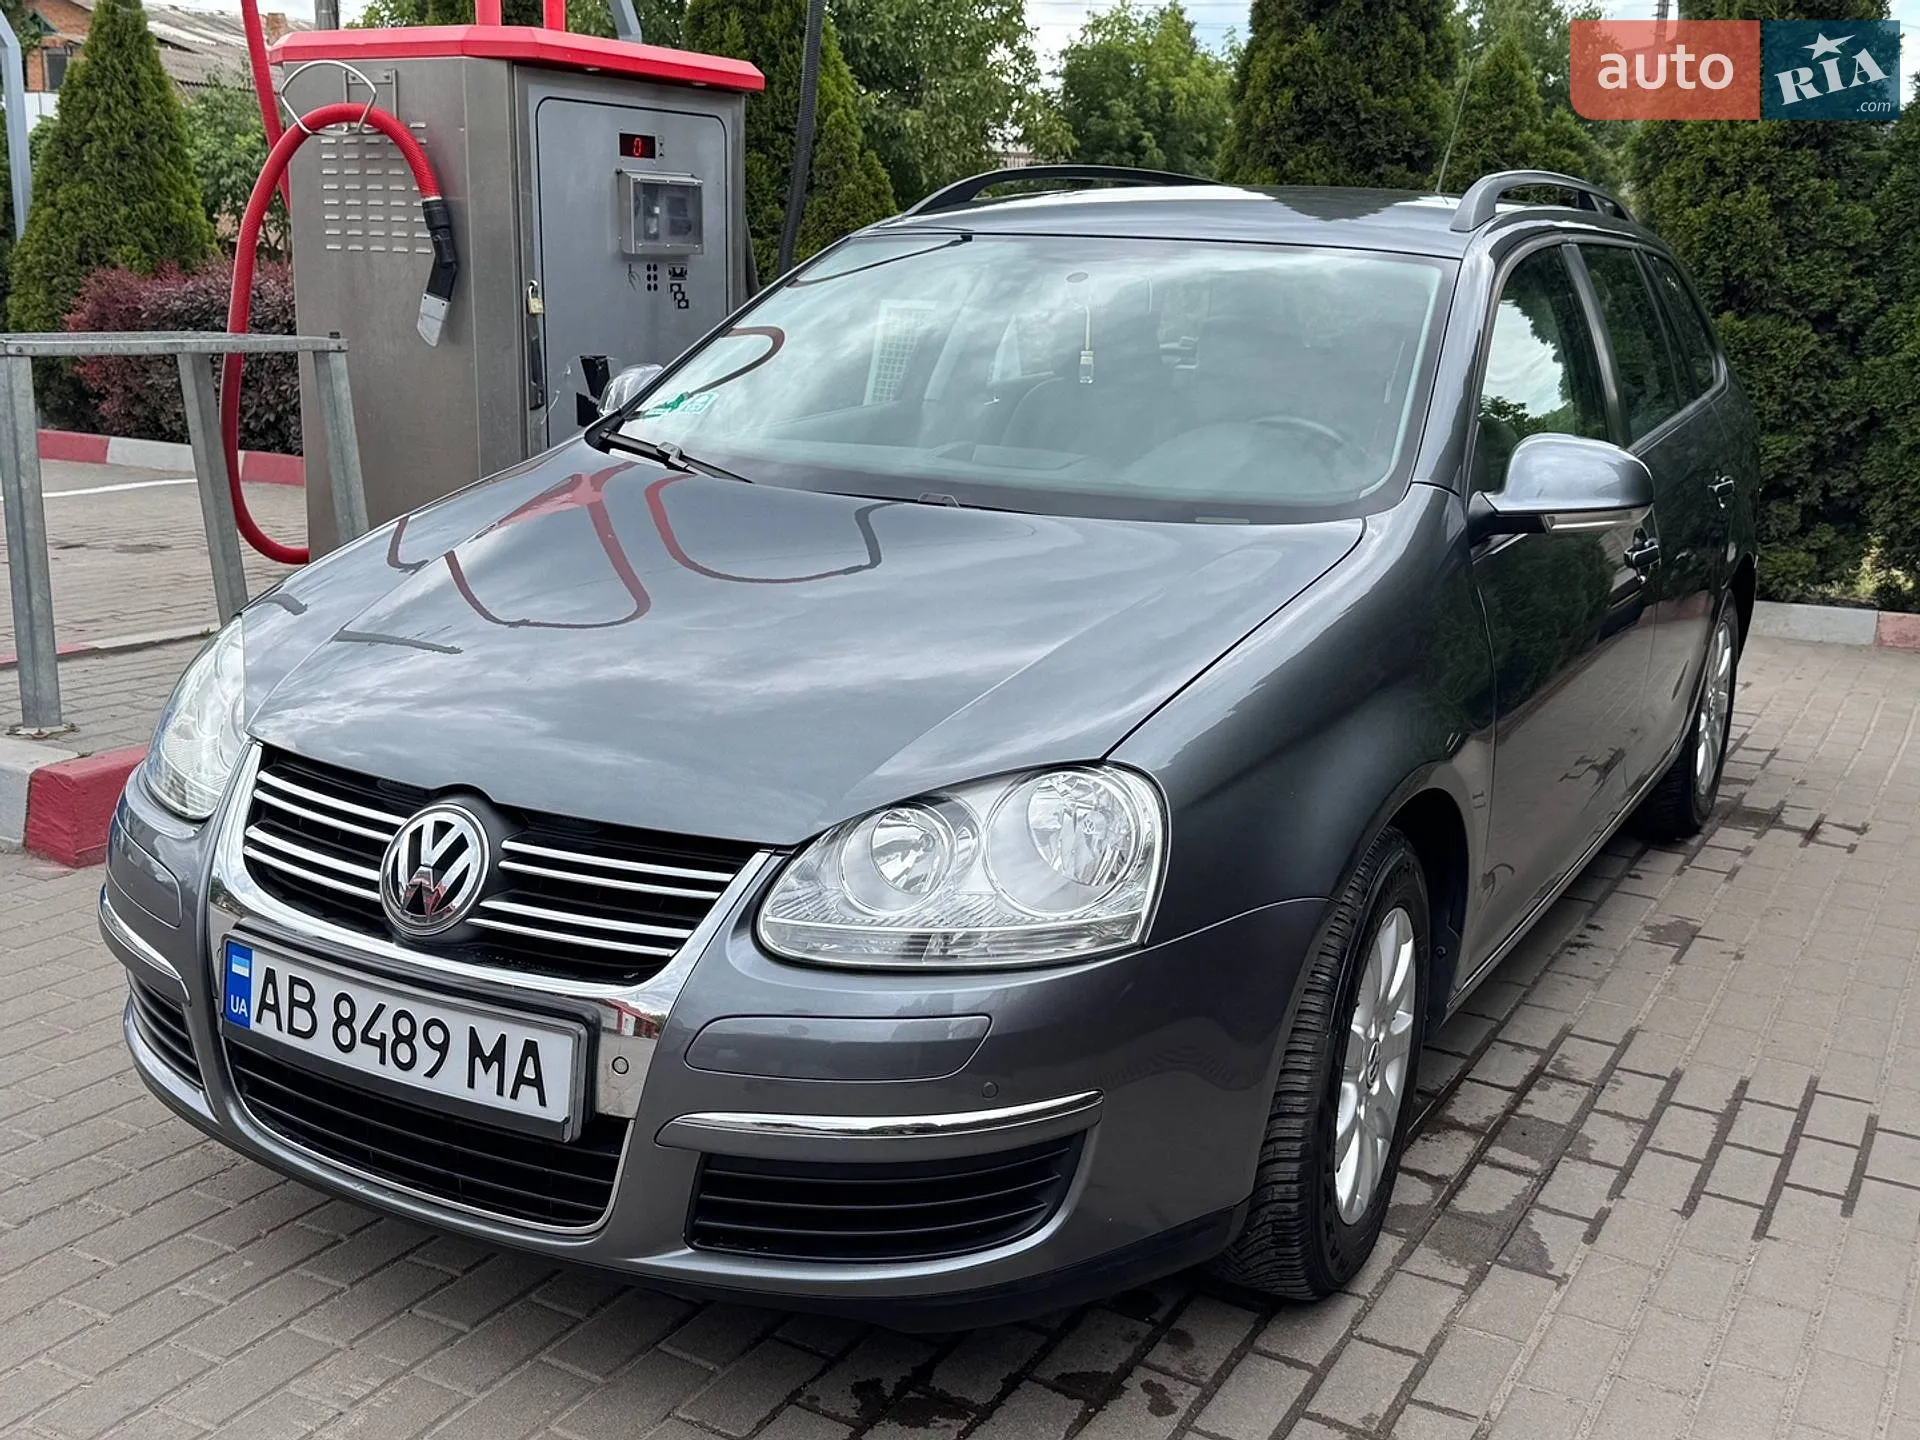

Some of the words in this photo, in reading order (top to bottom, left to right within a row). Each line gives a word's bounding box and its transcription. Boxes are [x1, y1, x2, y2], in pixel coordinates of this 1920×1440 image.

[231, 994, 248, 1017] UA
[255, 966, 318, 1040] AB
[332, 992, 451, 1078] 8489
[466, 1025, 547, 1107] MA
